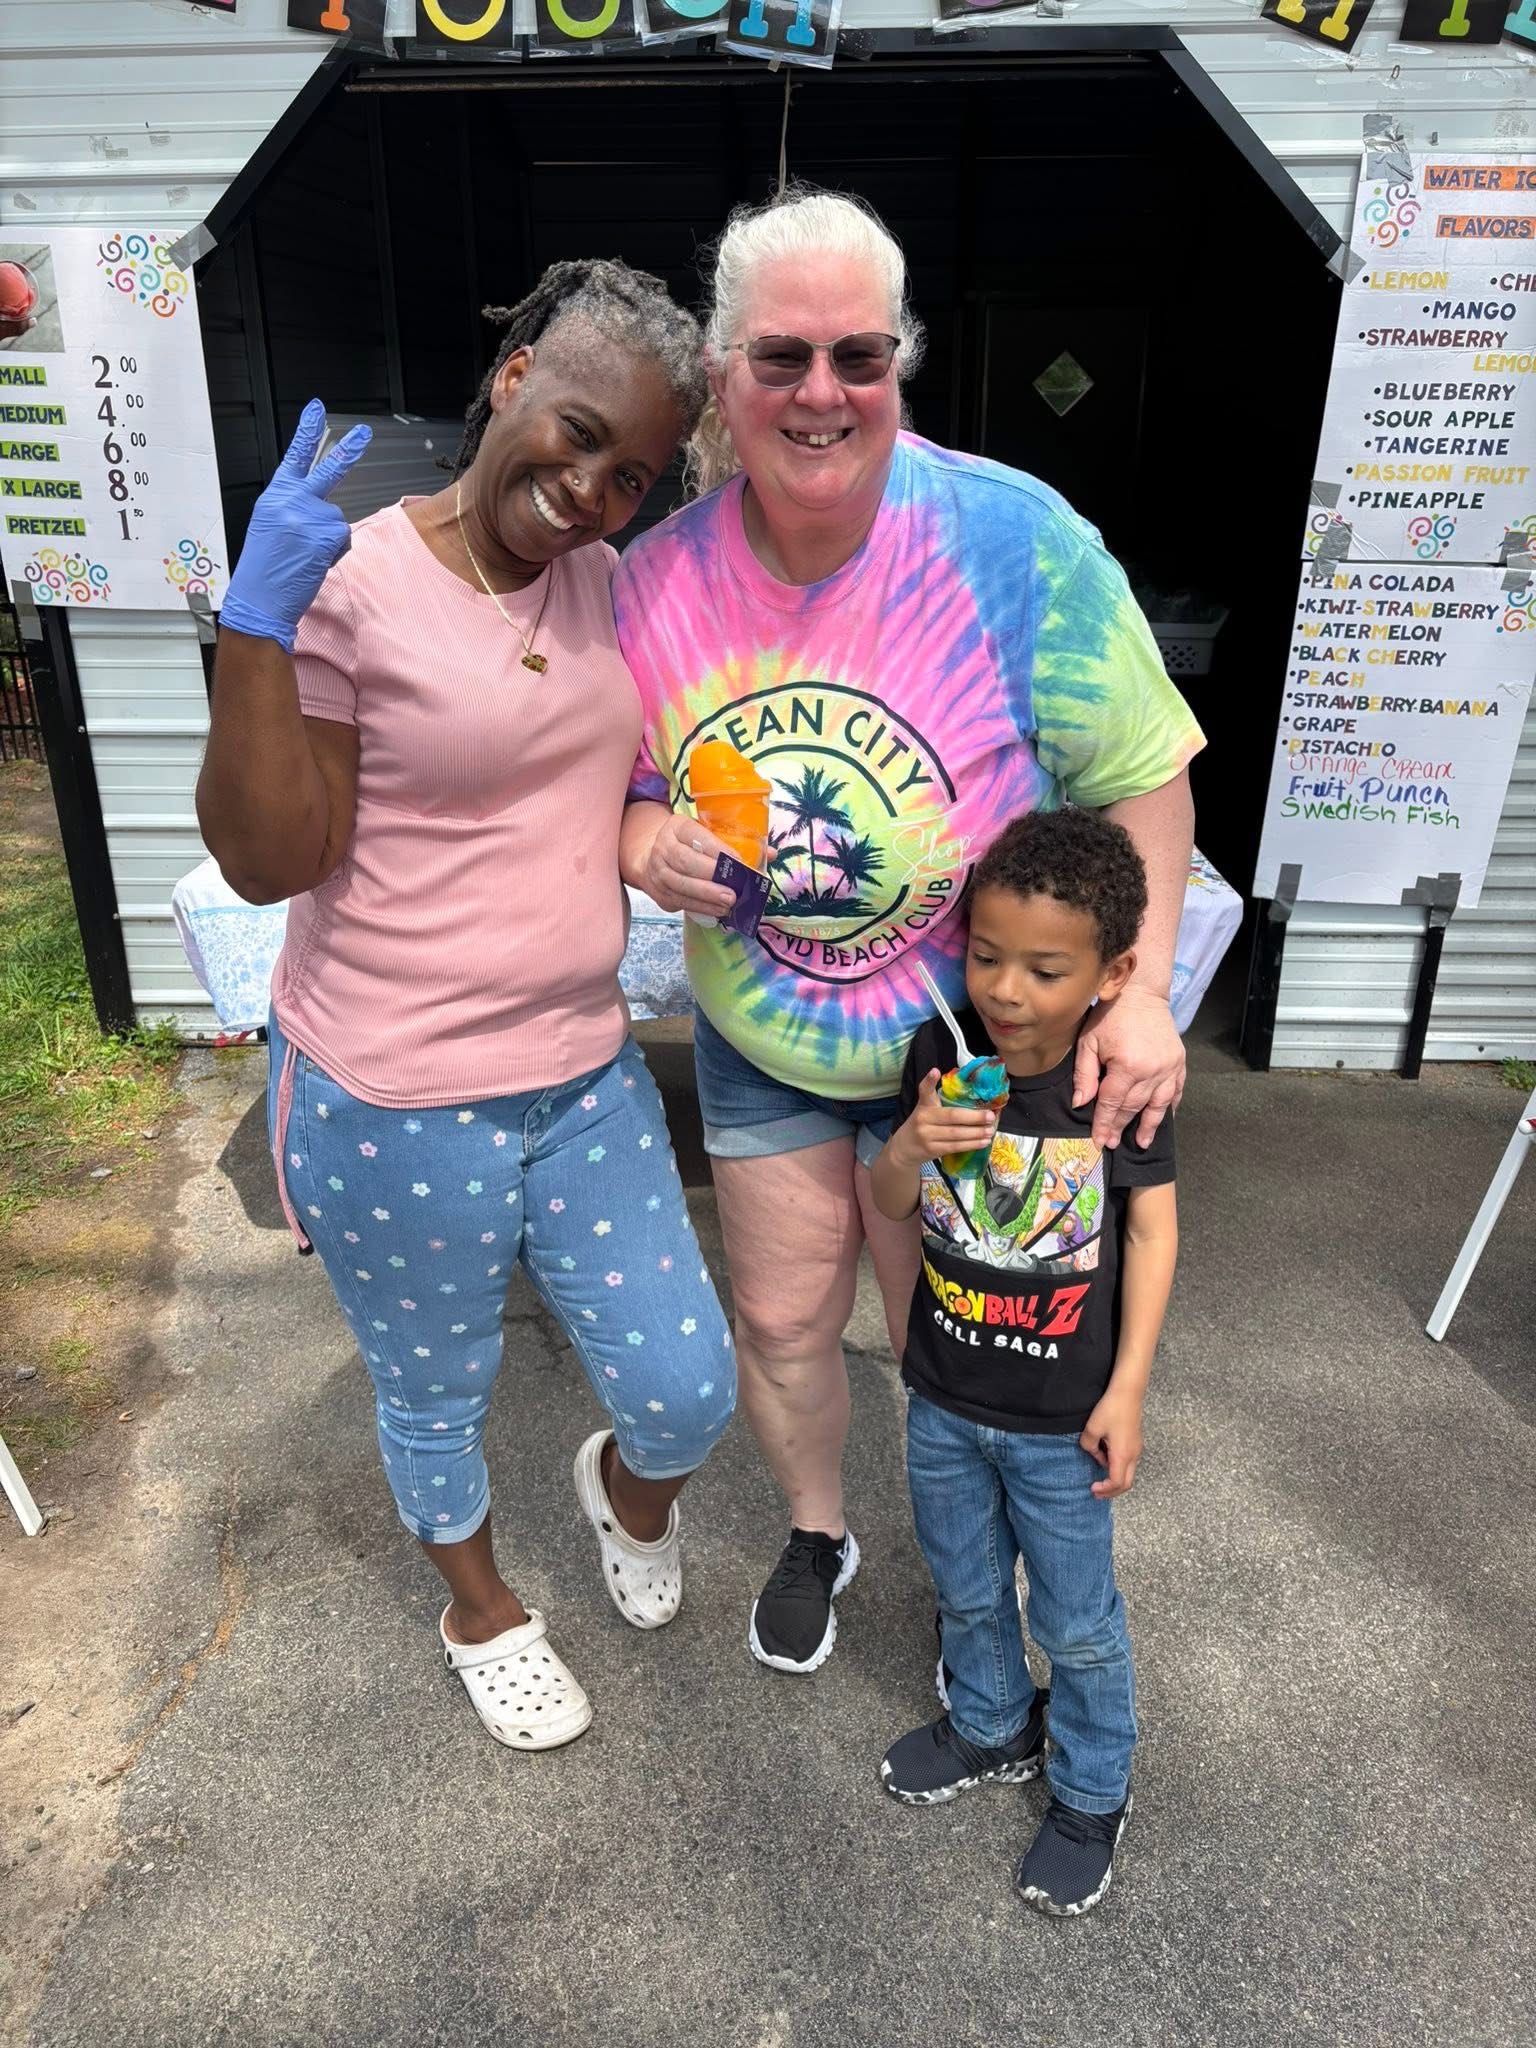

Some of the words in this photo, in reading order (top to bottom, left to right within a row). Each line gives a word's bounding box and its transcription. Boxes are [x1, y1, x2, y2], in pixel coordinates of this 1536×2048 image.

[1429, 169, 1502, 189] WATER
[1439, 217, 1532, 239] FLAVORS
[1370, 271, 1449, 290] LEMON
[1432, 301, 1516, 321] MANGO
[1366, 328, 1508, 348] STRAWBERRY
[1383, 383, 1516, 401] BLUEBERRY
[1372, 409, 1433, 428] SOUR
[1443, 411, 1515, 429] APPLE
[0, 442, 57, 461] LARGE
[1375, 436, 1510, 456] TANGERINE
[1353, 463, 1452, 482] PASSION
[1464, 465, 1530, 485] FRUIT
[4, 479, 16, 495] X
[22, 481, 82, 499] LARGE
[1357, 491, 1485, 509] PINEAPPLE
[8, 518, 86, 536] PRETZEL
[1369, 575, 1455, 592] COLADA
[1304, 598, 1500, 619] KIWI-STRAWBERRY
[1304, 622, 1442, 642] WATERMELON
[1298, 645, 1360, 663] BLACK
[1366, 648, 1447, 667] CHERRY
[1297, 669, 1366, 688] PEACH
[1293, 716, 1356, 733] GRAPE
[844, 710, 934, 794] CITY
[1288, 738, 1396, 757] PISTACHIO
[1359, 777, 1449, 807] Punch
[1406, 805, 1459, 829] Fish
[822, 926, 907, 967] BEACH
[904, 878, 953, 930] CLUB
[1038, 1283, 1091, 1336] Z
[934, 1310, 981, 1346] CELL
[994, 1334, 1059, 1360] SAGA
